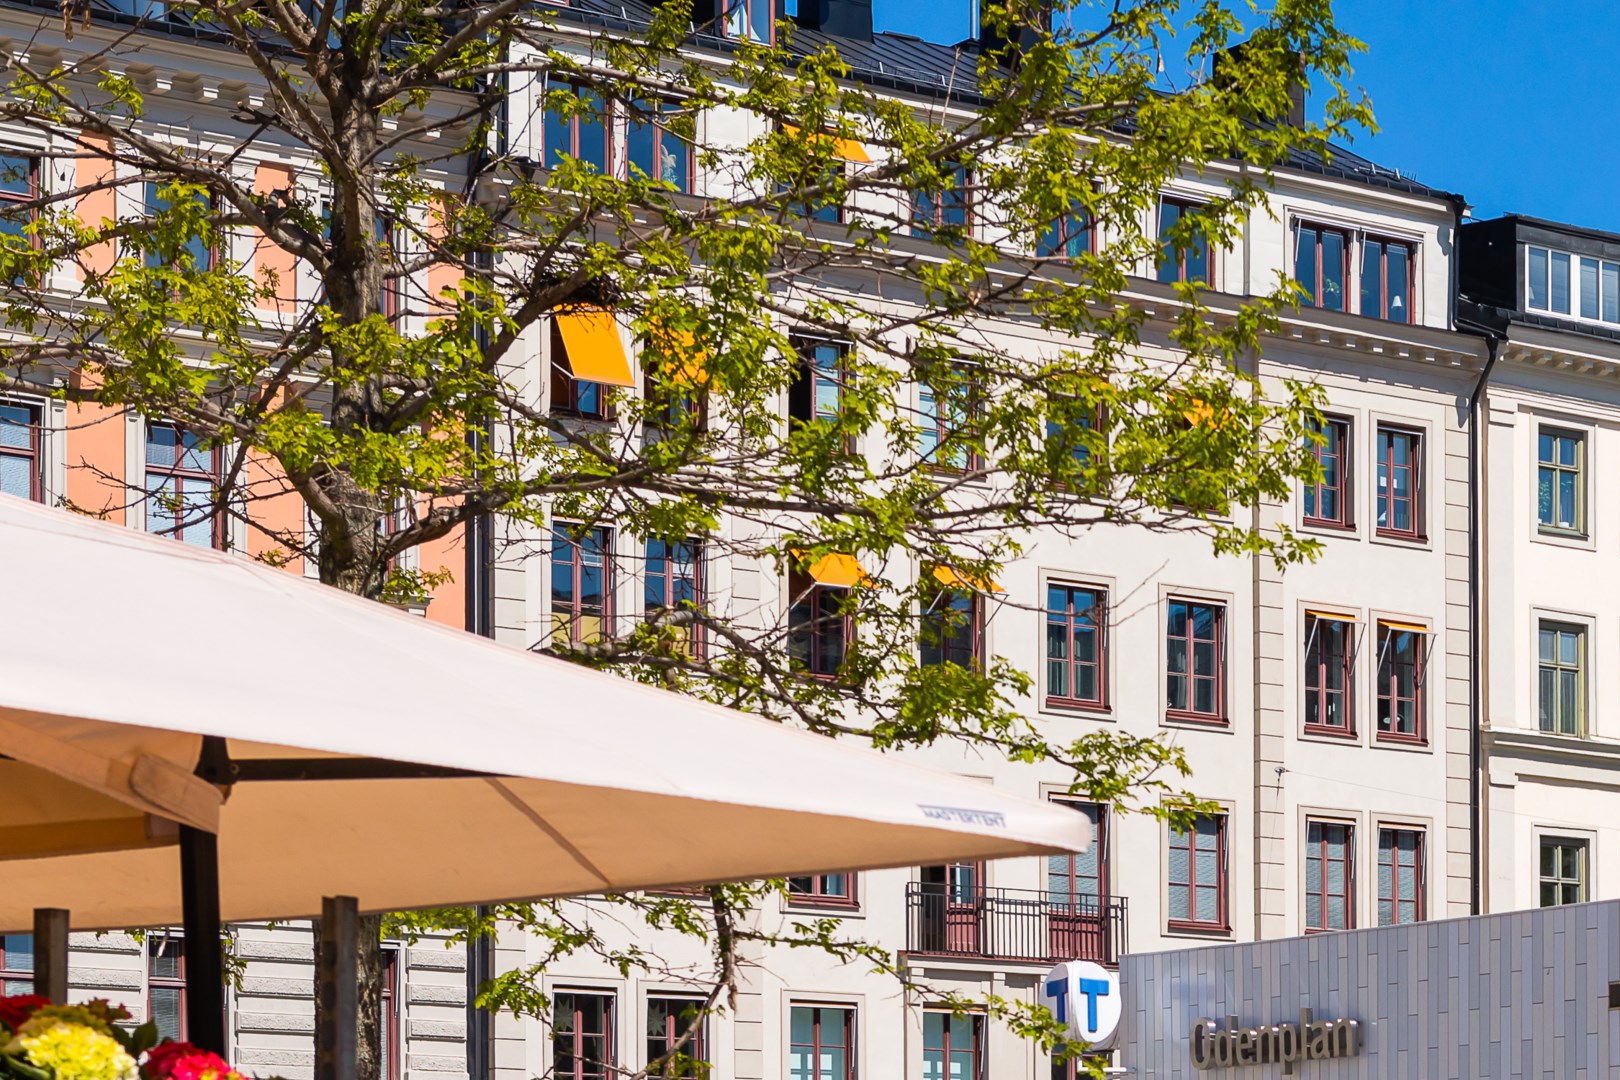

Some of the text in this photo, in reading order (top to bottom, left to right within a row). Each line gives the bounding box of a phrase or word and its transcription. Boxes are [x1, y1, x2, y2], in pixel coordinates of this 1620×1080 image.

[1047, 977, 1068, 1024] T
[1079, 977, 1109, 1033] T
[1190, 1007, 1362, 1075] Odenplan
